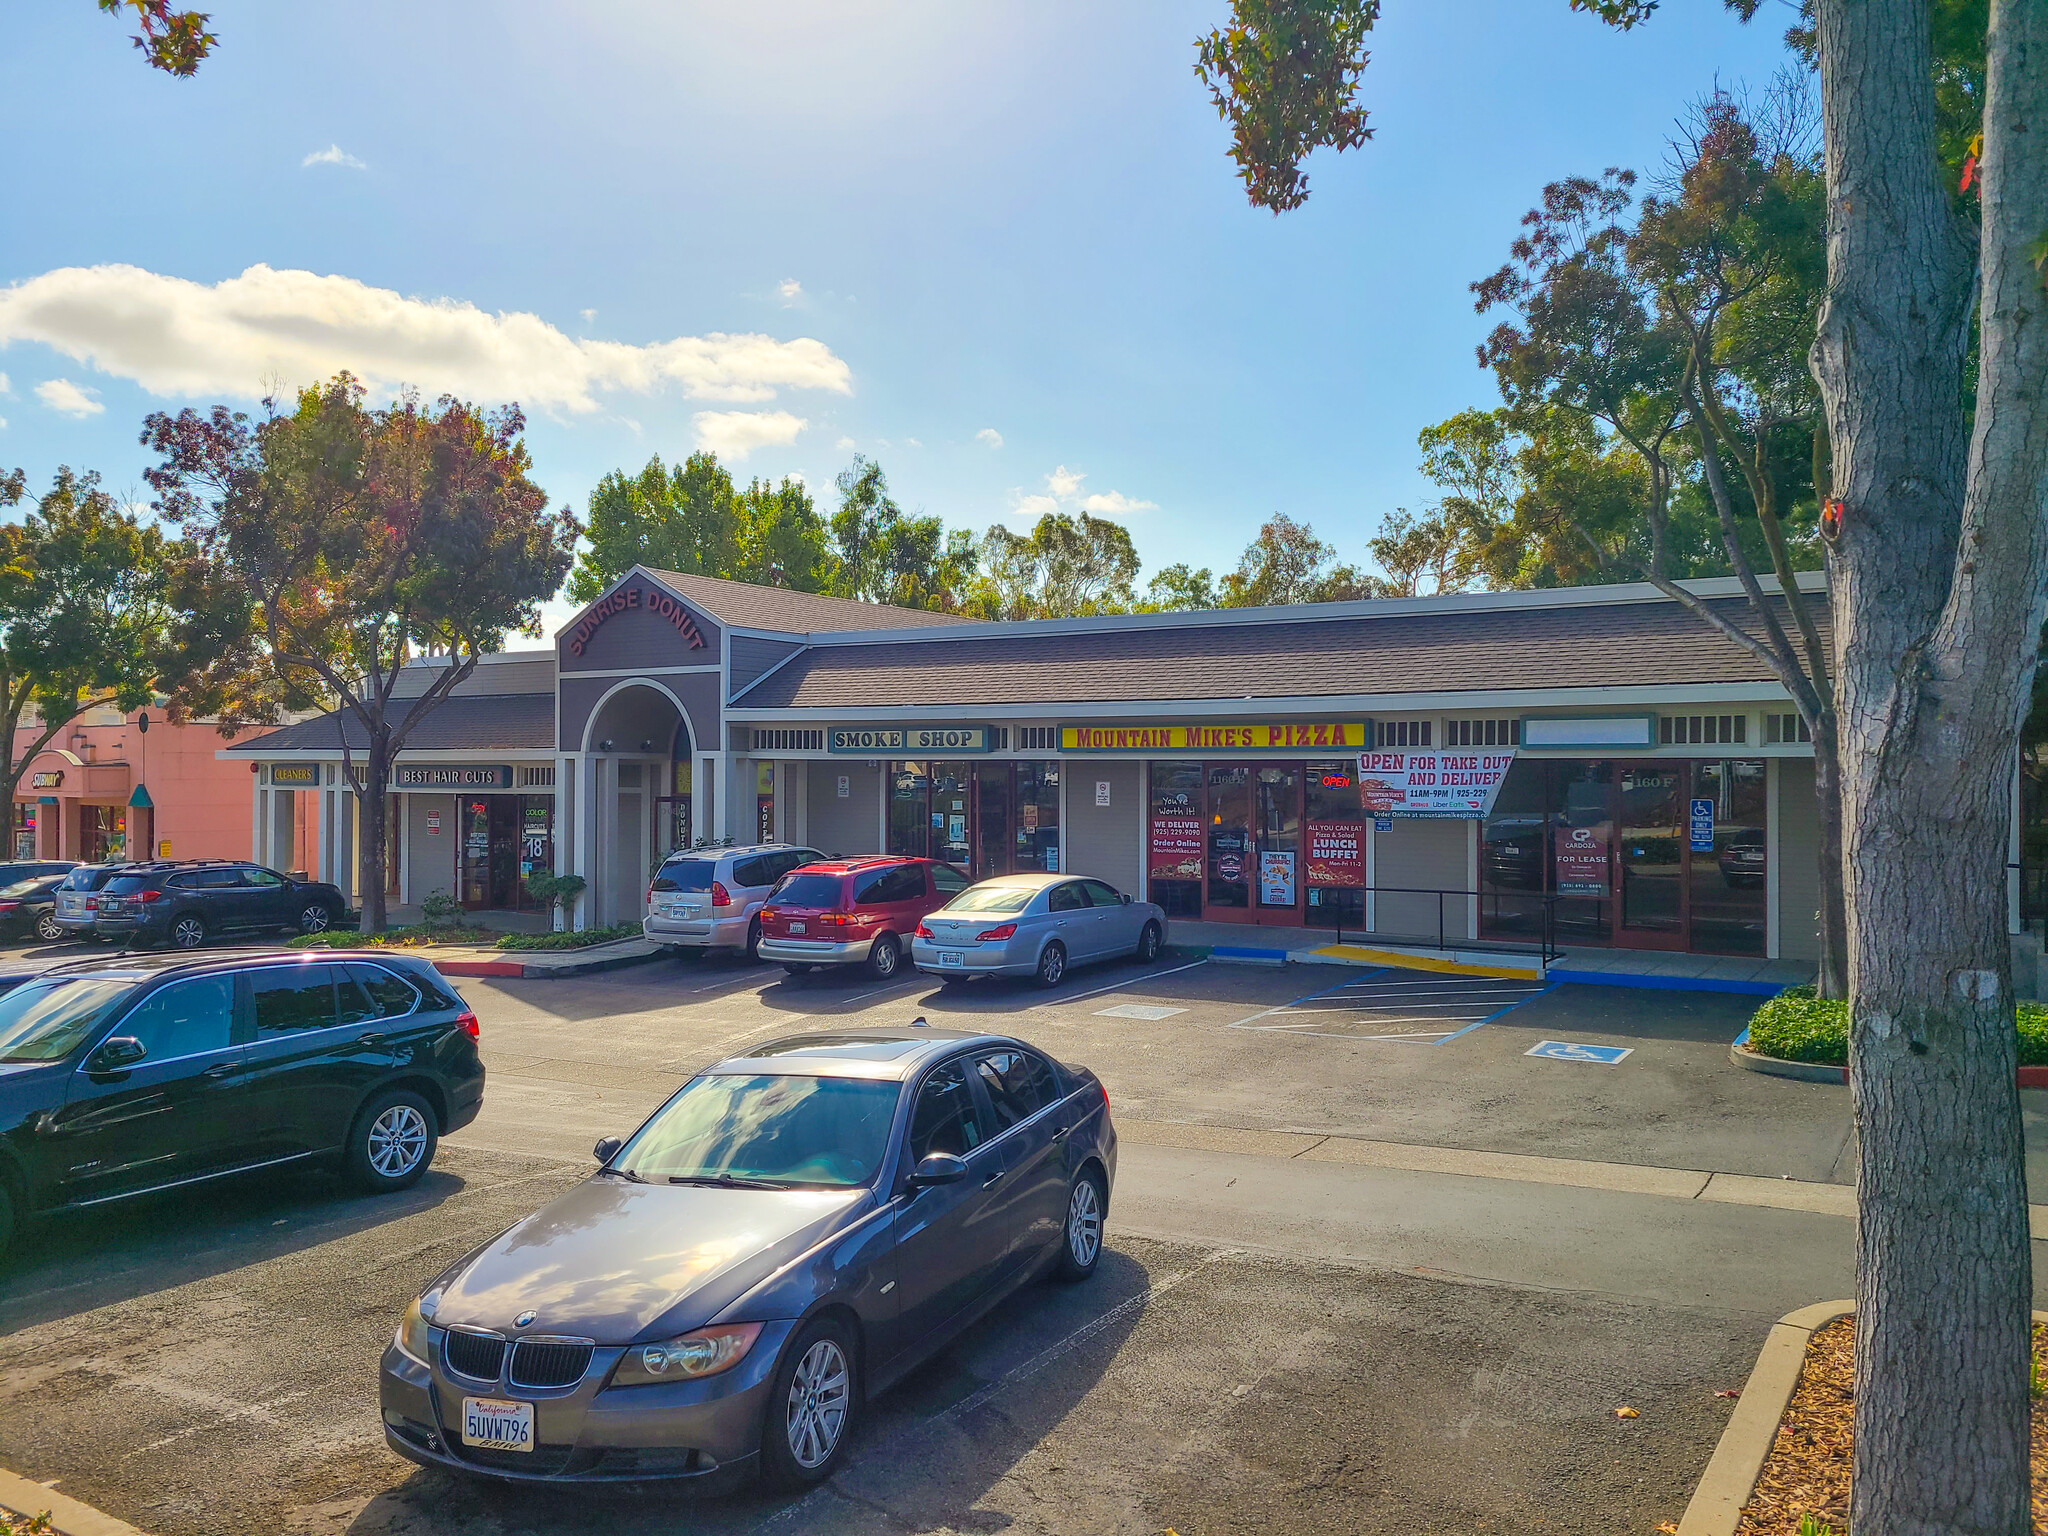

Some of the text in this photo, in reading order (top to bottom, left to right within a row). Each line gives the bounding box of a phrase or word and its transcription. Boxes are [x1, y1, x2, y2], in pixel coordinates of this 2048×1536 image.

[569, 589, 703, 657] SUNRISE DONUT
[835, 731, 973, 747] SMOKE SHOP
[1076, 724, 1346, 747] MOUNTAIN MIKE'S PIZZA
[1361, 754, 1511, 770] OPEN FOR TAKE OUT
[32, 773, 60, 786] SUBWAY
[274, 768, 312, 780] CLEANERS
[404, 771, 493, 783] BEST HAIR CUTS
[1408, 773, 1436, 786] AND
[1322, 775, 1350, 787] OPEN
[1410, 789, 1448, 797] 11AM-9PM
[1162, 796, 1189, 806] You're
[525, 808, 547, 816] COLOR
[1159, 806, 1184, 816] Worth
[1167, 821, 1200, 829] DELIVER
[1153, 828, 1169, 836] (925)
[1153, 839, 1201, 848] Order Online
[1313, 839, 1357, 849] LUNCH
[1312, 849, 1359, 859] BUFFET
[478, 1404, 516, 1416] California
[468, 1415, 529, 1442] 5UVW796
[479, 1440, 521, 1449] BMW
